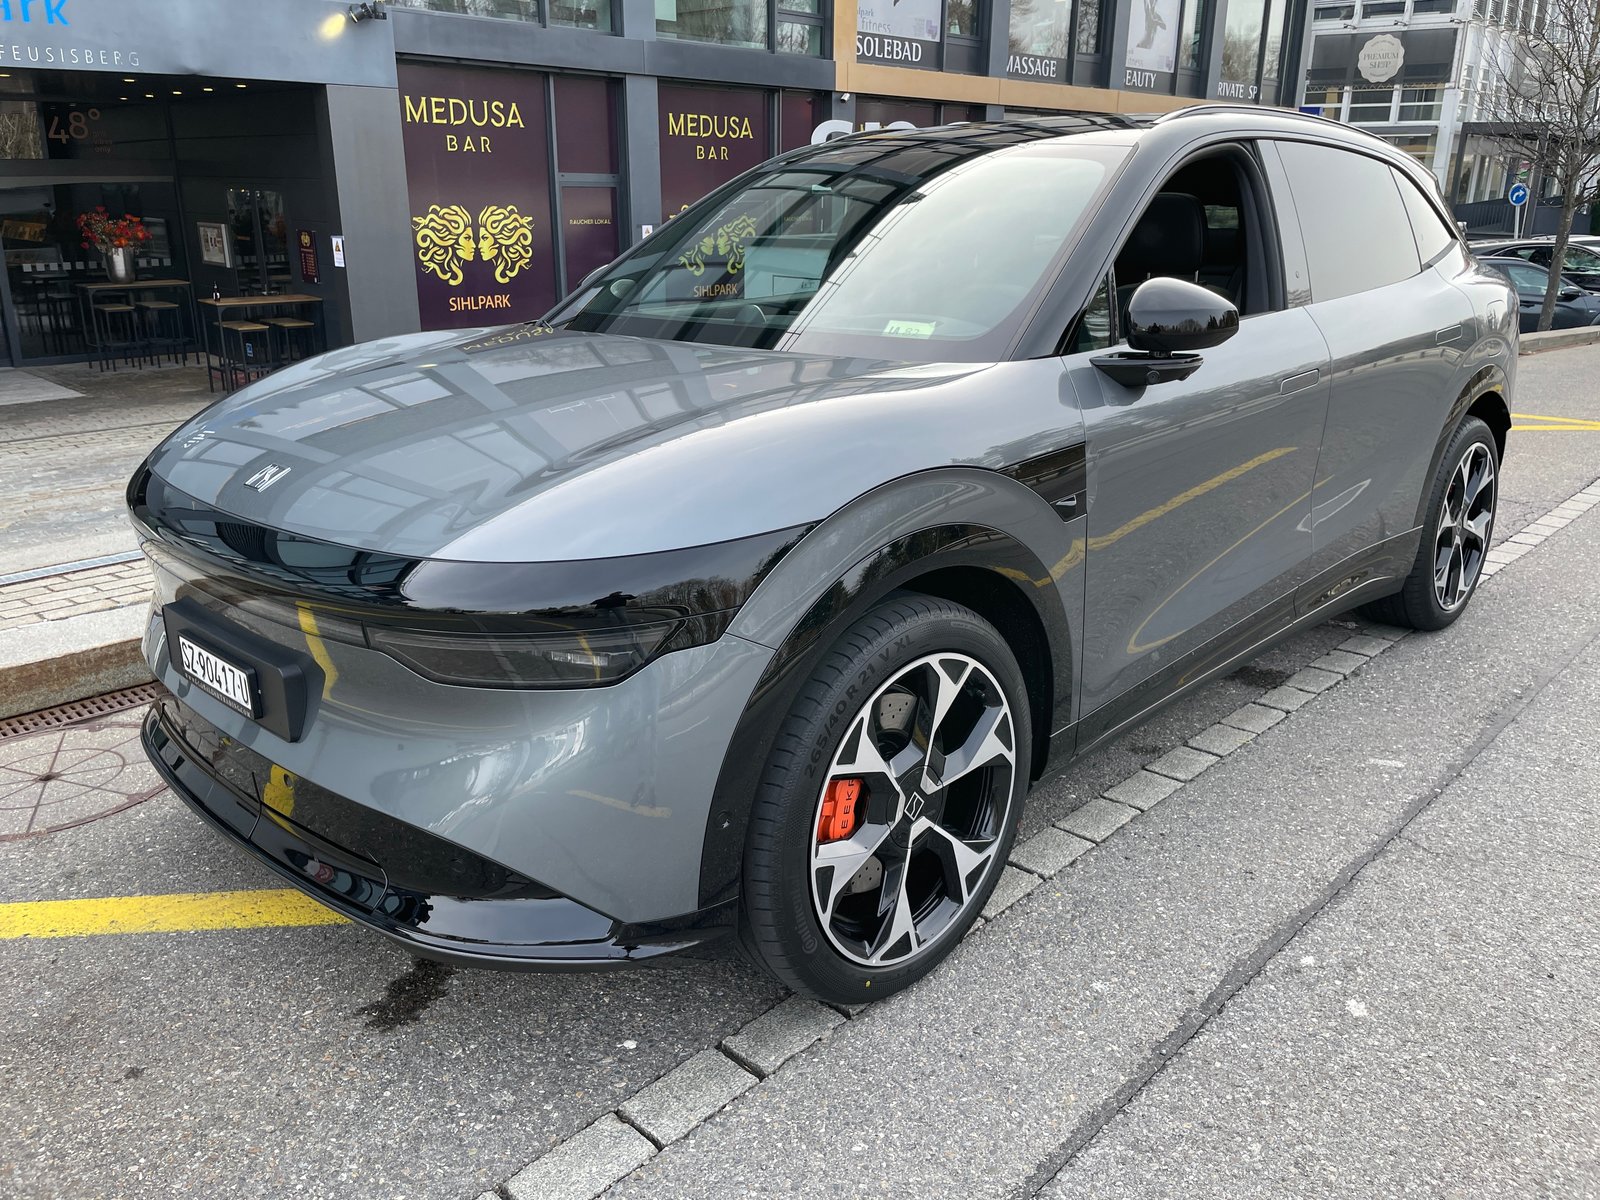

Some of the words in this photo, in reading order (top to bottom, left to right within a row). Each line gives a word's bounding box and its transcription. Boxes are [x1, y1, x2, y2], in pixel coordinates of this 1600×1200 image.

[856, 35, 922, 62] SOLEBAD
[1363, 52, 1399, 61] PREMIUM
[1123, 70, 1157, 89] EAUTY
[404, 95, 525, 128] MEDUSA
[667, 112, 754, 139] MEDUSA
[446, 135, 492, 154] BAR
[695, 145, 730, 161] BAR
[693, 283, 738, 298] SIHLPARK
[449, 294, 512, 312] SIHLPARK
[804, 701, 848, 778] 265/40
[846, 686, 859, 700] R
[858, 664, 876, 686] 21
[879, 648, 892, 662] V
[894, 634, 917, 651] XL
